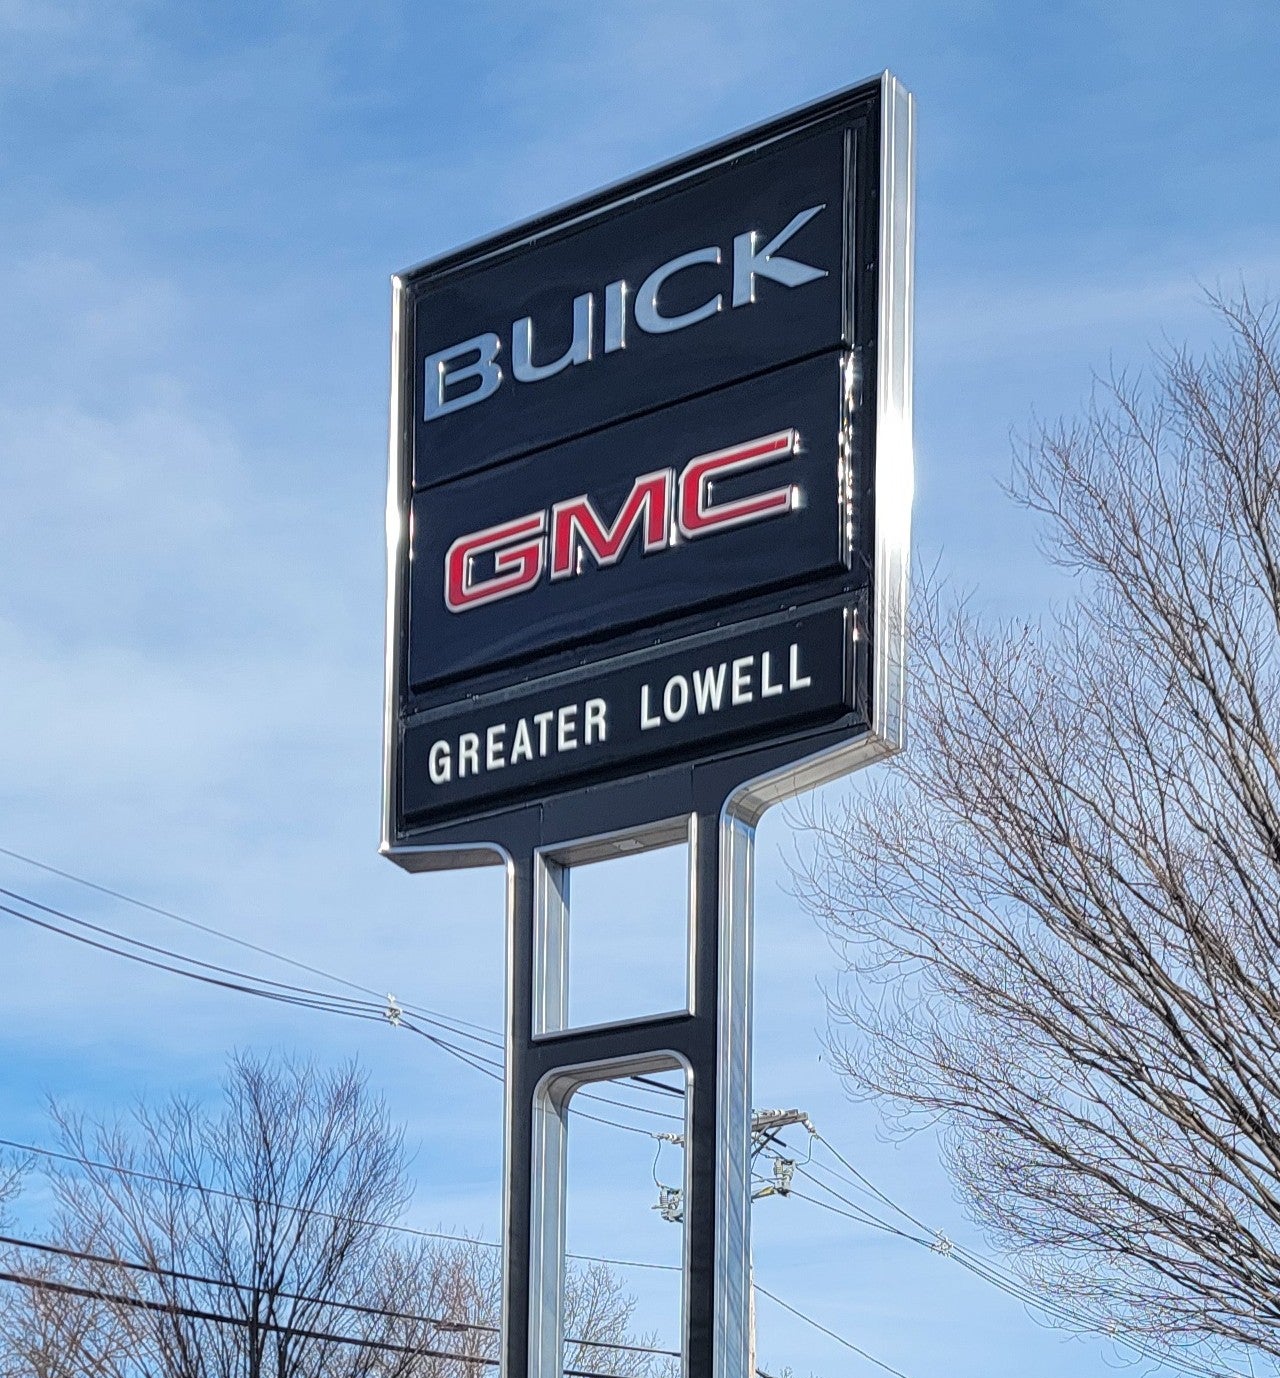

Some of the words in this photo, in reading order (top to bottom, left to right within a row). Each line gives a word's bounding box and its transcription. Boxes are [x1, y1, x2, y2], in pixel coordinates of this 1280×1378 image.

[423, 203, 829, 422] BUICK
[445, 427, 800, 613] GMC
[428, 697, 608, 785] GREATER
[640, 643, 812, 731] LOWELL
